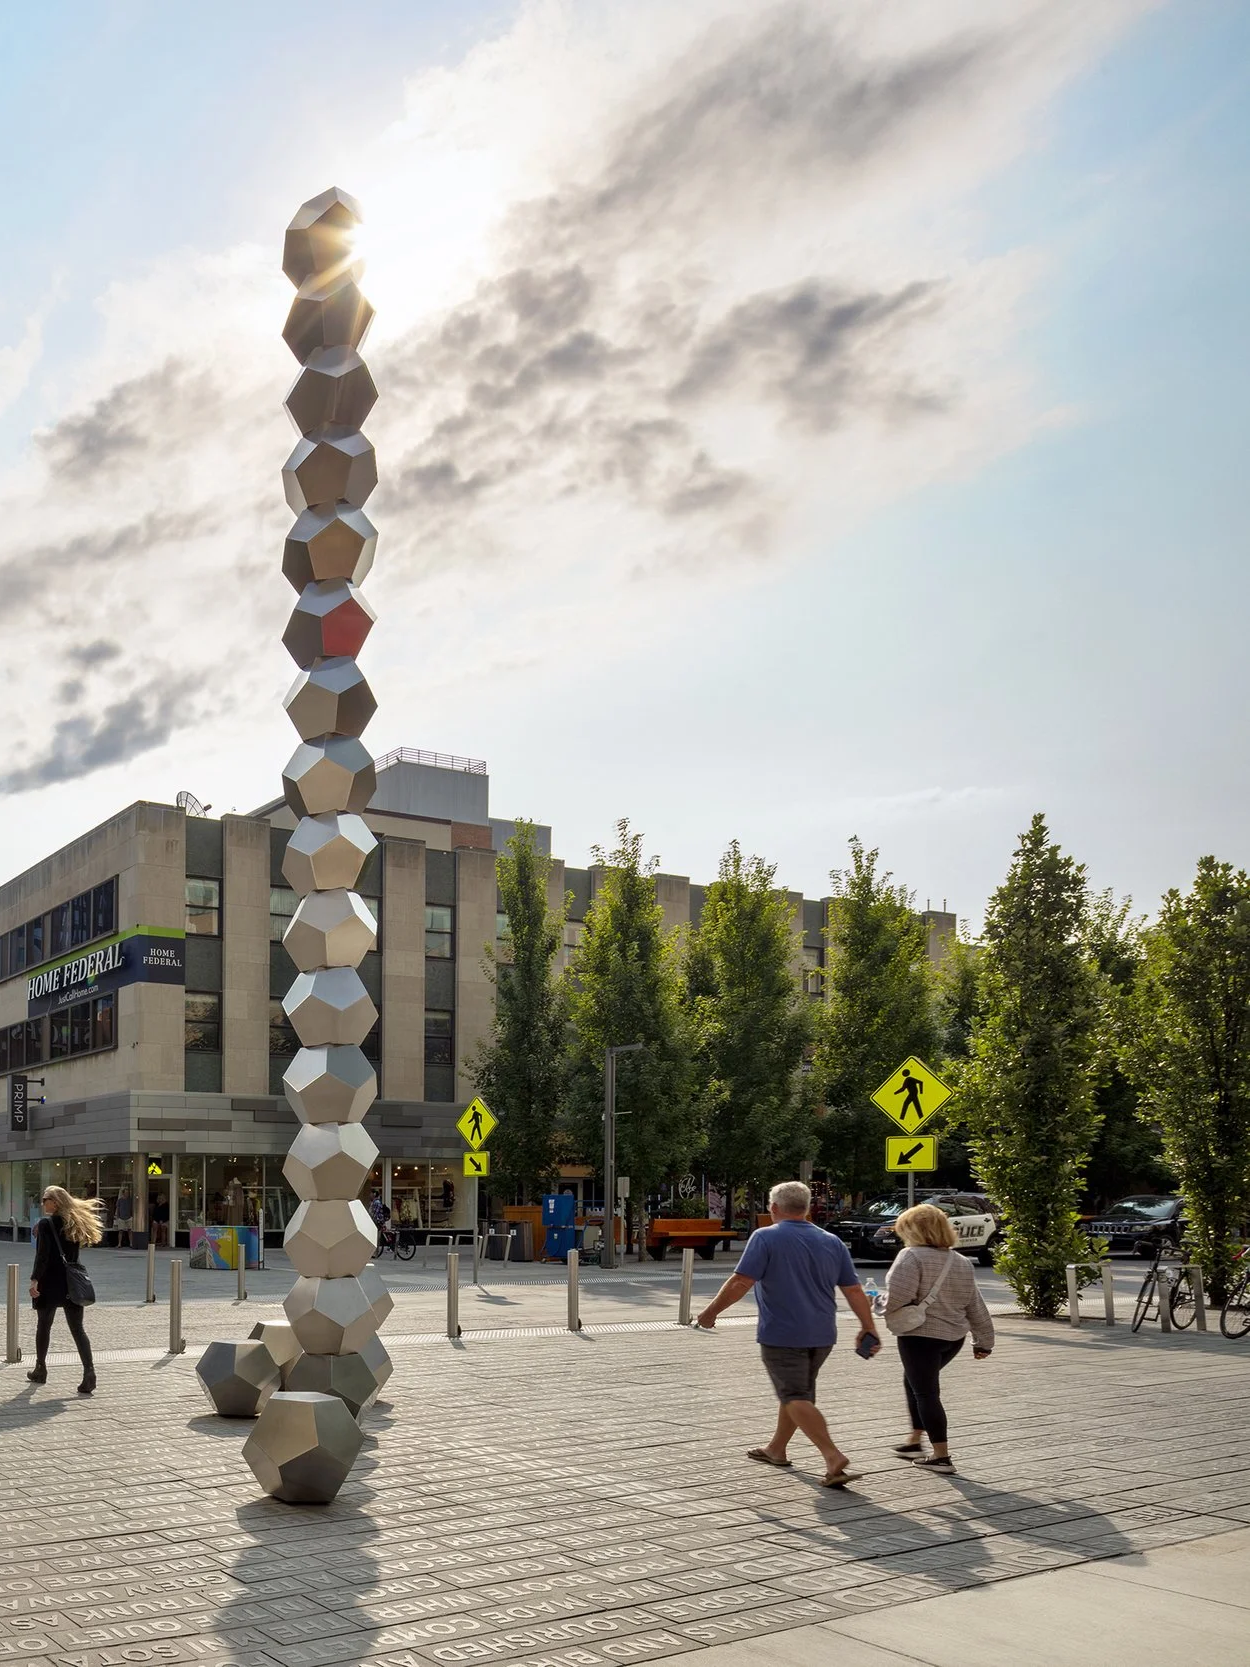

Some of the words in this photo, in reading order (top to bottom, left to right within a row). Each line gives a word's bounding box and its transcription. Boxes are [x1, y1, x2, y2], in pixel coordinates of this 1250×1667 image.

[142, 956, 183, 967] FEDERAL
[150, 948, 176, 958] HOME
[27, 968, 60, 1001] HOME
[62, 942, 124, 988] FEDERAL
[13, 1082, 24, 1124] PRIMP
[956, 1225, 985, 1238] LICE
[418, 1474, 526, 1492] FOLLOW
[502, 1483, 551, 1495] ARE
[123, 1493, 193, 1506] SONG
[437, 1489, 502, 1501] THE
[50, 1501, 108, 1514] FOR
[126, 1505, 187, 1516] AND
[368, 1497, 442, 1512] LAKE
[475, 1499, 533, 1511] THE
[39, 1512, 121, 1527] FALL
[398, 1507, 474, 1521] LAND
[432, 1512, 531, 1532] LISTEN
[579, 1510, 660, 1526] SANG
[365, 1527, 427, 1541] AND
[521, 1523, 586, 1534] THE
[616, 1520, 699, 1537] SANG
[86, 1535, 162, 1548] THE
[446, 1530, 522, 1546] STEM
[556, 1533, 621, 1546] THE
[657, 1531, 728, 1548] WILL
[120, 1543, 205, 1560] SEED
[324, 1549, 393, 1564] THE
[397, 1542, 438, 1554] OF
[475, 1541, 560, 1558] STEM
[573, 1542, 664, 1564] FORM
[52, 1555, 115, 1569] WE
[145, 1559, 216, 1575] THE
[232, 1559, 324, 1577] TREE
[339, 1554, 476, 1579] BECAME
[543, 1556, 574, 1567] A
[592, 1557, 689, 1581] FROM
[40, 1568, 141, 1588] EDGE
[305, 1574, 332, 1585] A
[446, 1561, 544, 1583] GIANT
[122, 1574, 228, 1597] GREW
[208, 1580, 306, 1602] TREE
[479, 1573, 599, 1602] BDOTE
[663, 1569, 731, 1596] ALL
[315, 1578, 441, 1606] CIRCLE
[586, 1583, 672, 1603] WAS
[68, 1596, 206, 1621] TRUNK
[273, 1599, 315, 1613] IN
[345, 1593, 483, 1624] WHERE
[479, 1596, 589, 1624] MADE
[651, 1586, 787, 1617] PEOPLE
[9, 1615, 59, 1631] AS
[187, 1608, 270, 1627] THE
[681, 1602, 830, 1640] ANIMALS
[66, 1622, 183, 1647] QUIET
[268, 1617, 351, 1639] THE
[432, 1611, 660, 1662] FLOURISHED
[185, 1631, 268, 1654] MNI
[276, 1618, 481, 1663] COMPLETE
[600, 1631, 683, 1657] AND
[57, 1644, 180, 1666] SOTA
[506, 1650, 603, 1667] BIR
